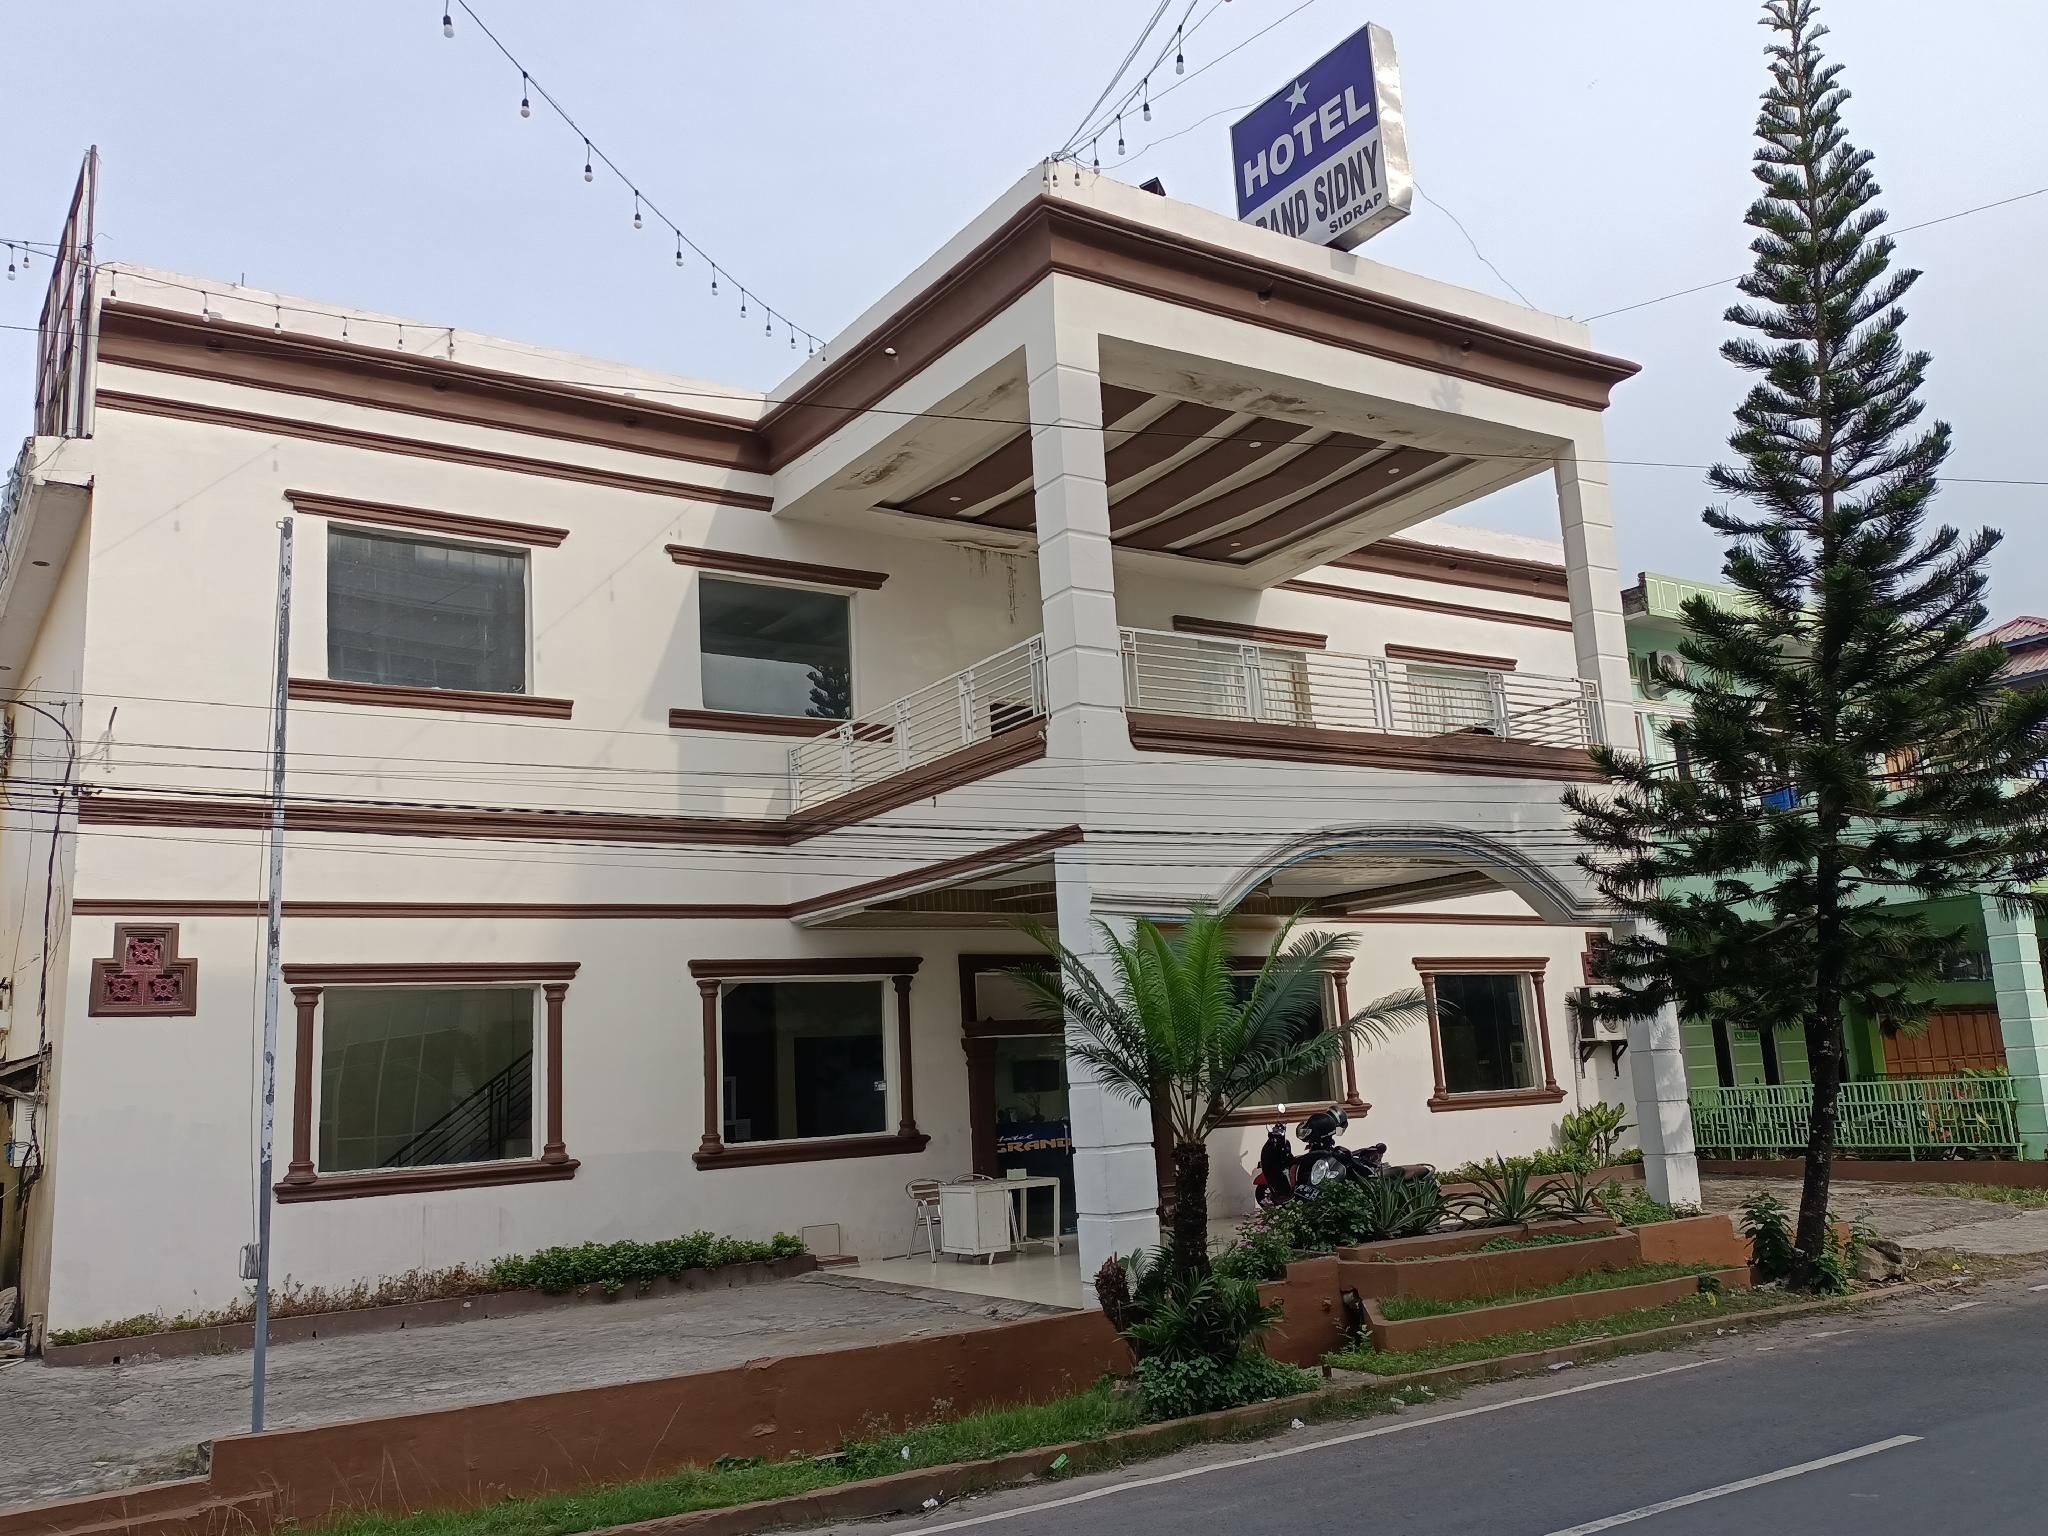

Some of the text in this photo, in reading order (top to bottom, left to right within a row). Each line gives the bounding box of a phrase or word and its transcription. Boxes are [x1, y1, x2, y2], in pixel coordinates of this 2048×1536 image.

[1243, 85, 1371, 198] HOTEL
[1255, 139, 1378, 239] AND SIDNY
[1329, 192, 1383, 234] SIDRAP
